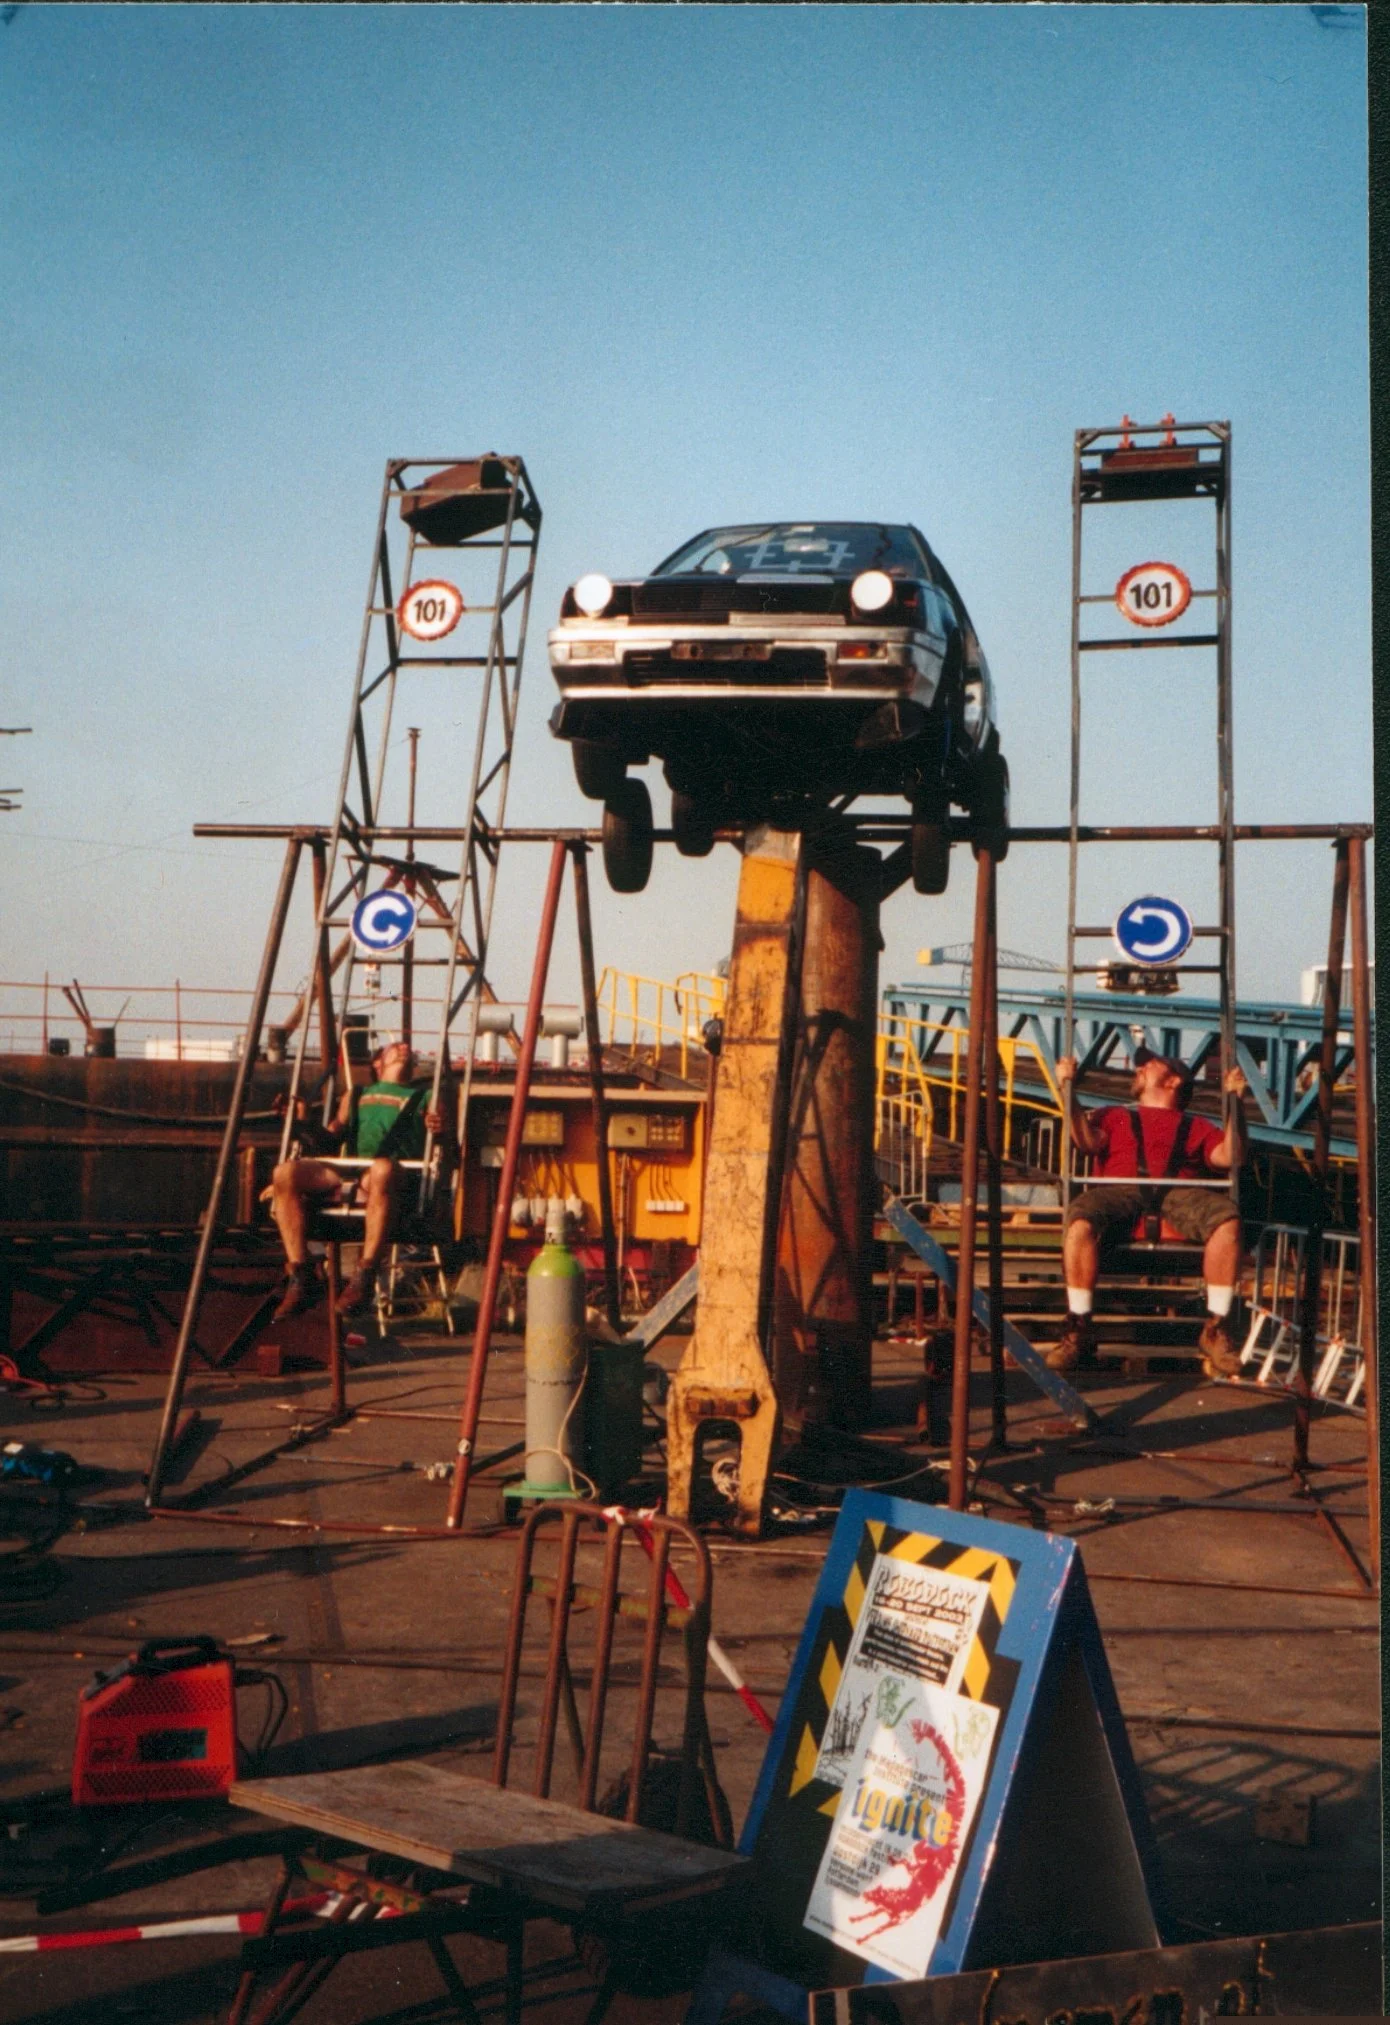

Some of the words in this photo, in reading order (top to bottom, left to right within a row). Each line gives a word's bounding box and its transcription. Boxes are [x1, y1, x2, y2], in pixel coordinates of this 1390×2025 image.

[1130, 581, 1171, 609] 101
[414, 598, 446, 623] 101
[852, 1775, 953, 1849] ignite
